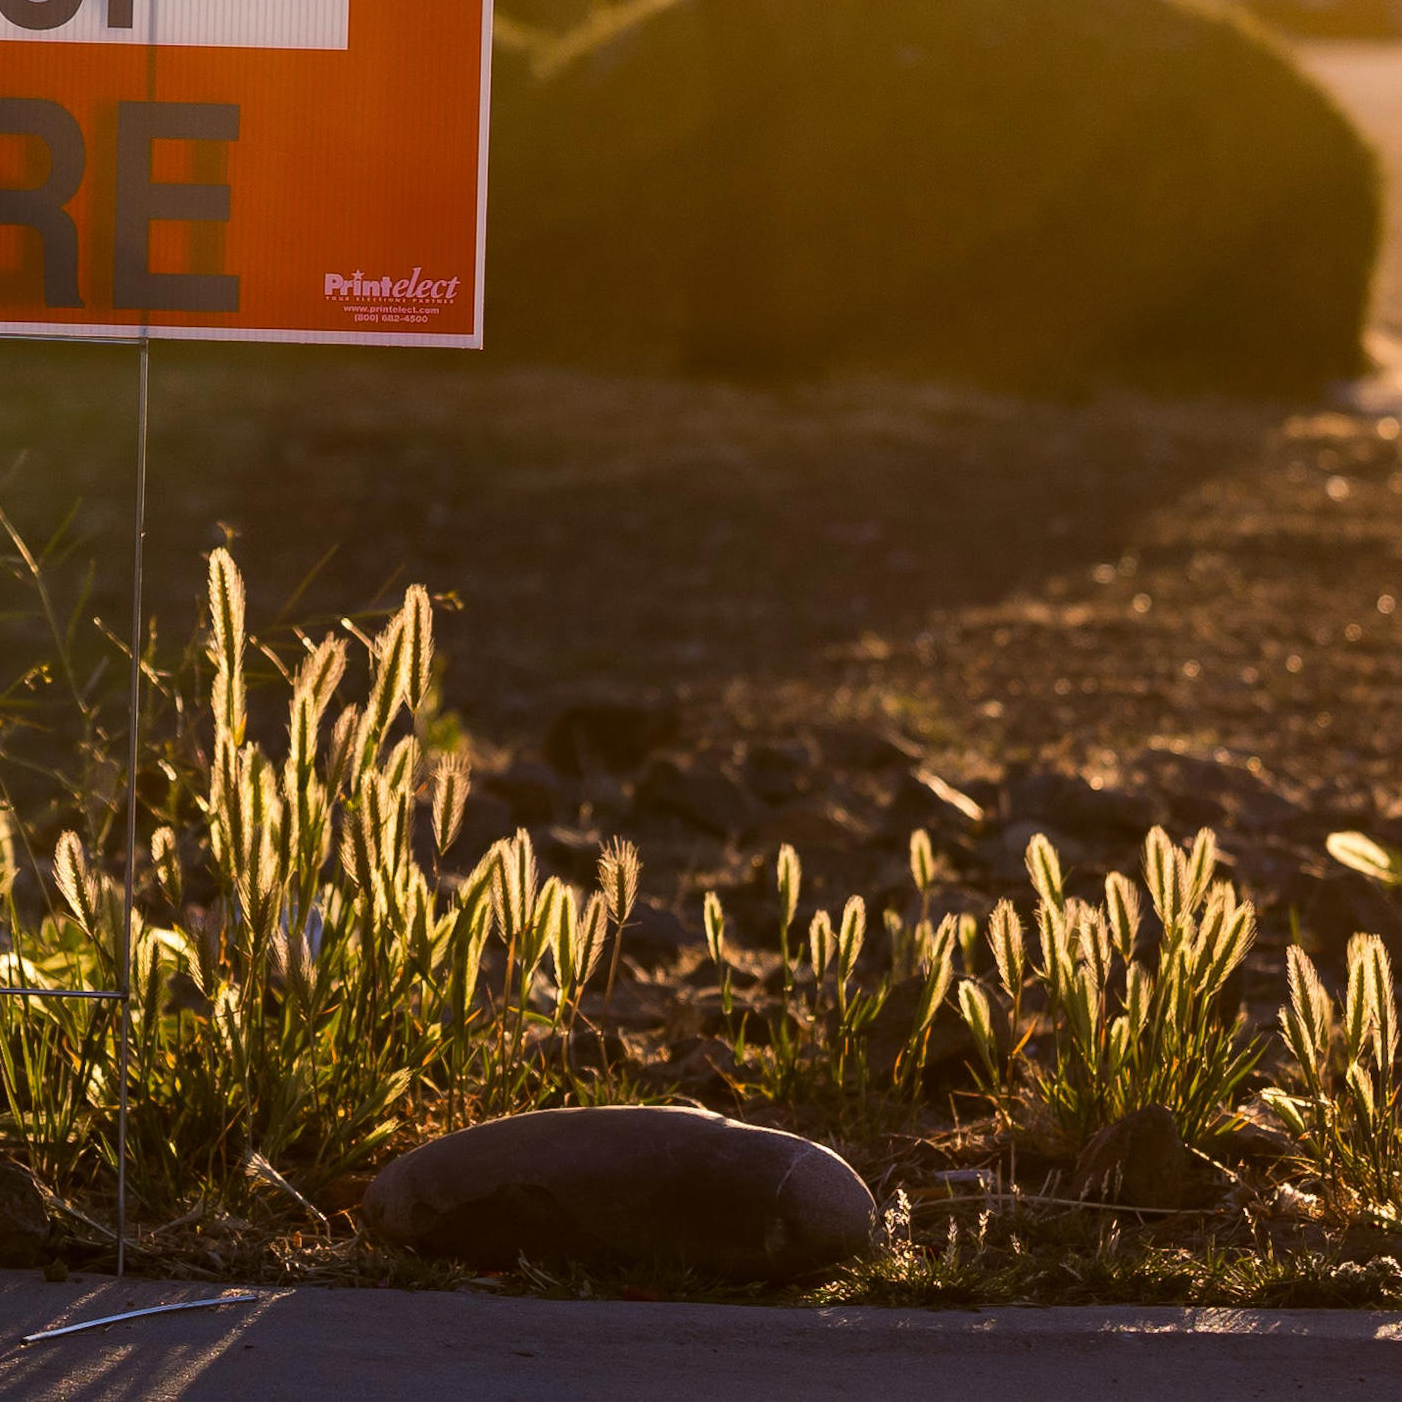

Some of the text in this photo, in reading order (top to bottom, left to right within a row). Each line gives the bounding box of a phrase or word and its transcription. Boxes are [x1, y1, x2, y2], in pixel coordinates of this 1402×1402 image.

[324, 267, 461, 299] Printelect
[343, 305, 440, 315] www.printelect.com
[355, 314, 429, 324] (800) 682-4500
